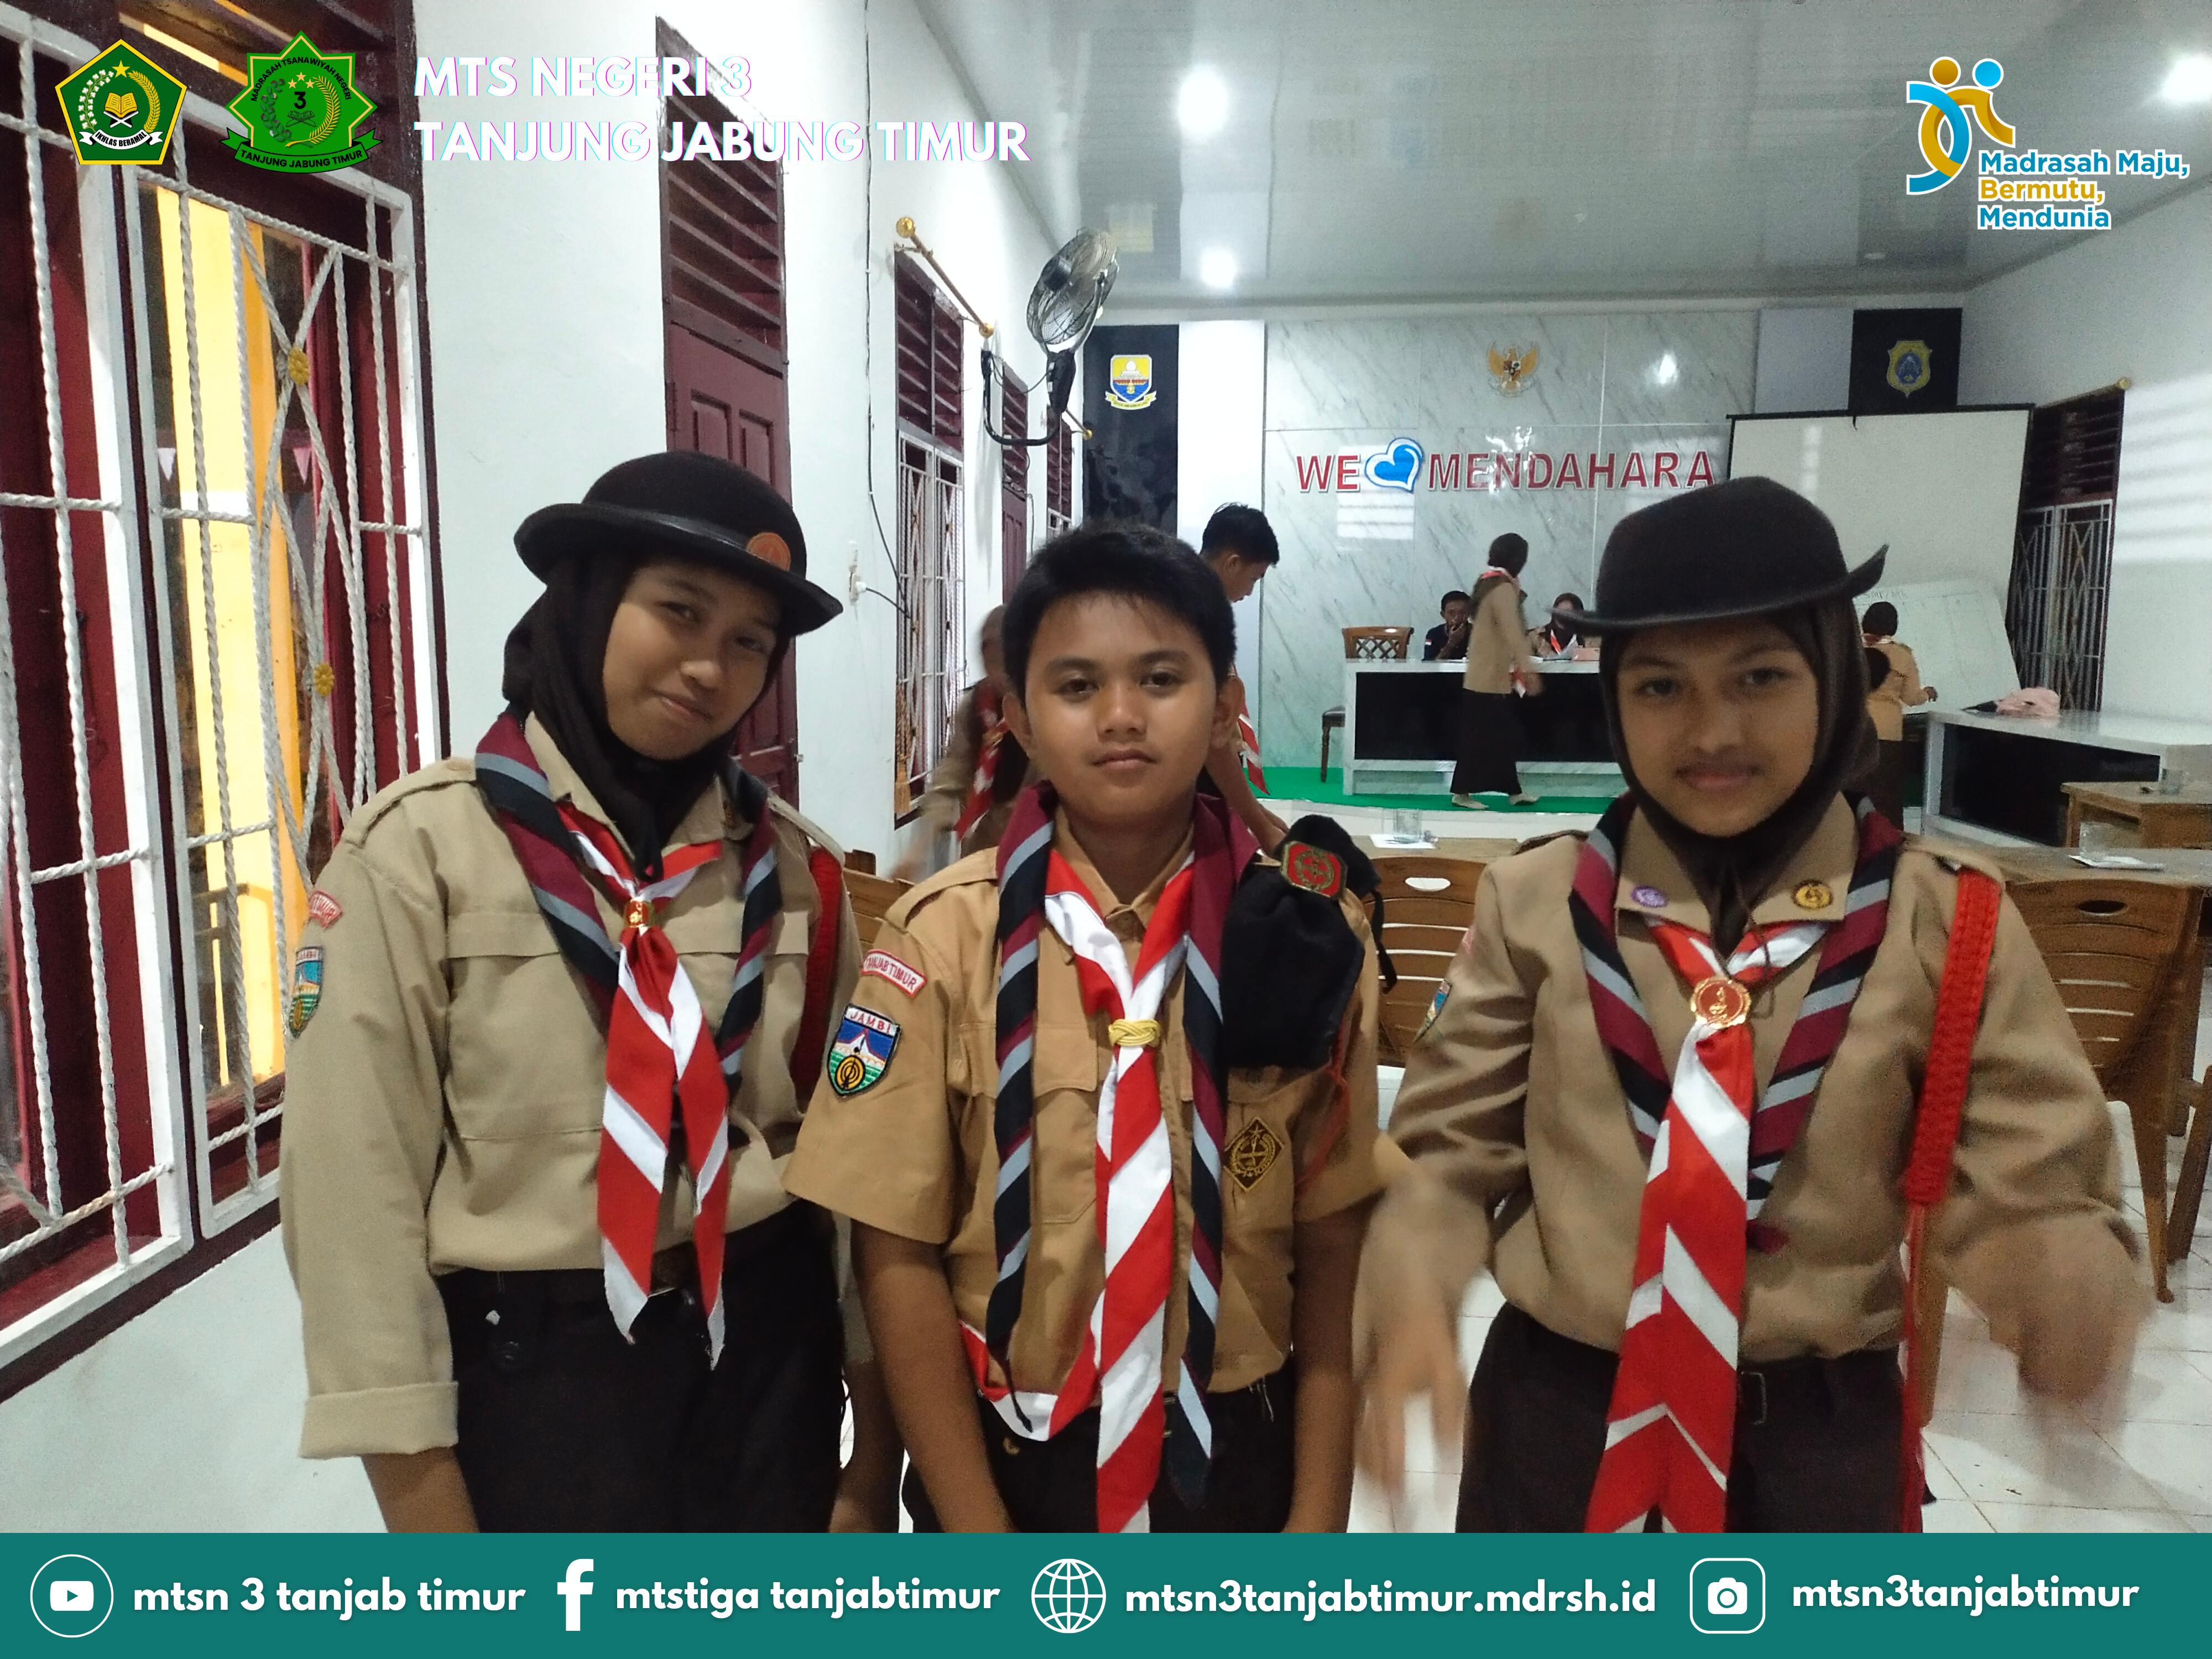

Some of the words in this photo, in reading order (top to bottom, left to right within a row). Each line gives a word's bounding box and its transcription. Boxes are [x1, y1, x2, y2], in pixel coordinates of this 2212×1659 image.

[1295, 454, 1361, 492] WE
[1428, 450, 1714, 491] MENDAHARA
[890, 963, 917, 990] TIMUR
[850, 1011, 891, 1034] JAMBI
